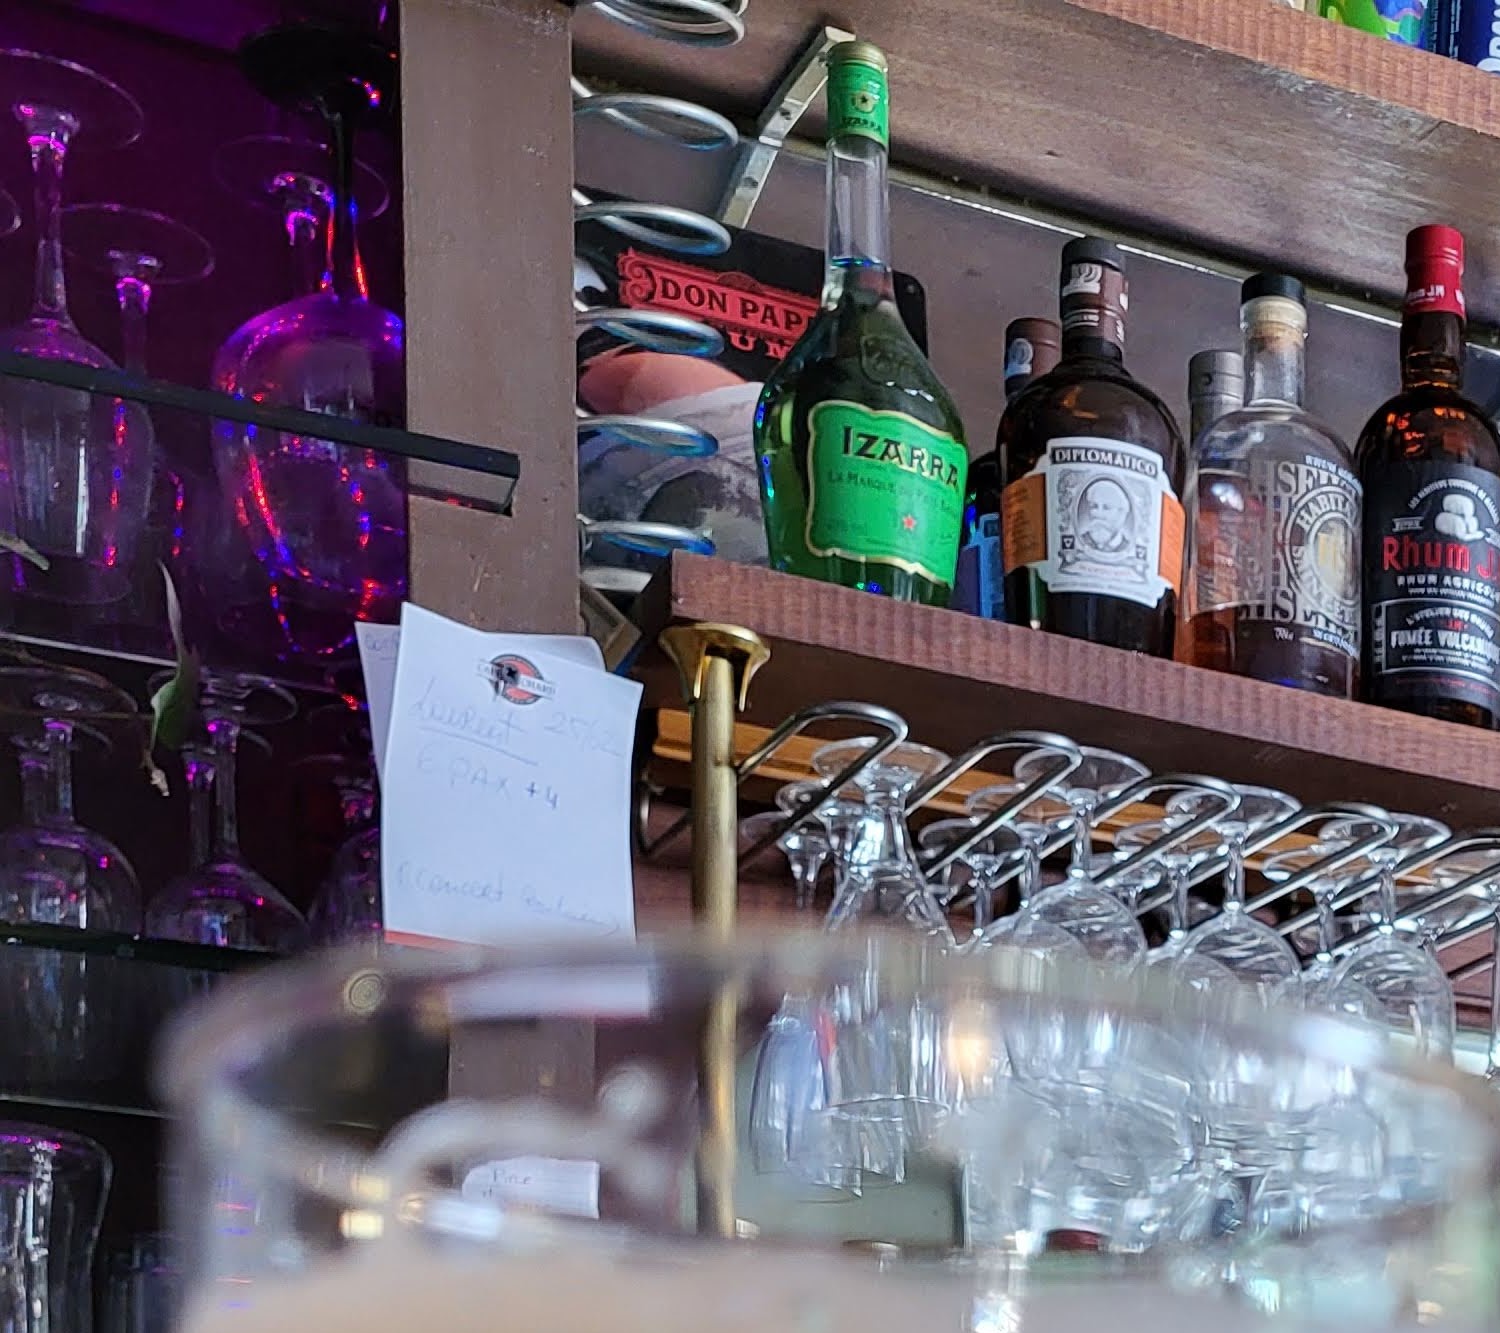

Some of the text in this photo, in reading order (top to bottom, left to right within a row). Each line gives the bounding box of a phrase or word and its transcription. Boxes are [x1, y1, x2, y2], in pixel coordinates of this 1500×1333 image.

[660, 276, 812, 332] DON PAP
[725, 328, 795, 361] UM
[841, 424, 961, 495] IZARRA
[1382, 533, 1471, 573] Rhum
[1396, 573, 1438, 587] RHUM
